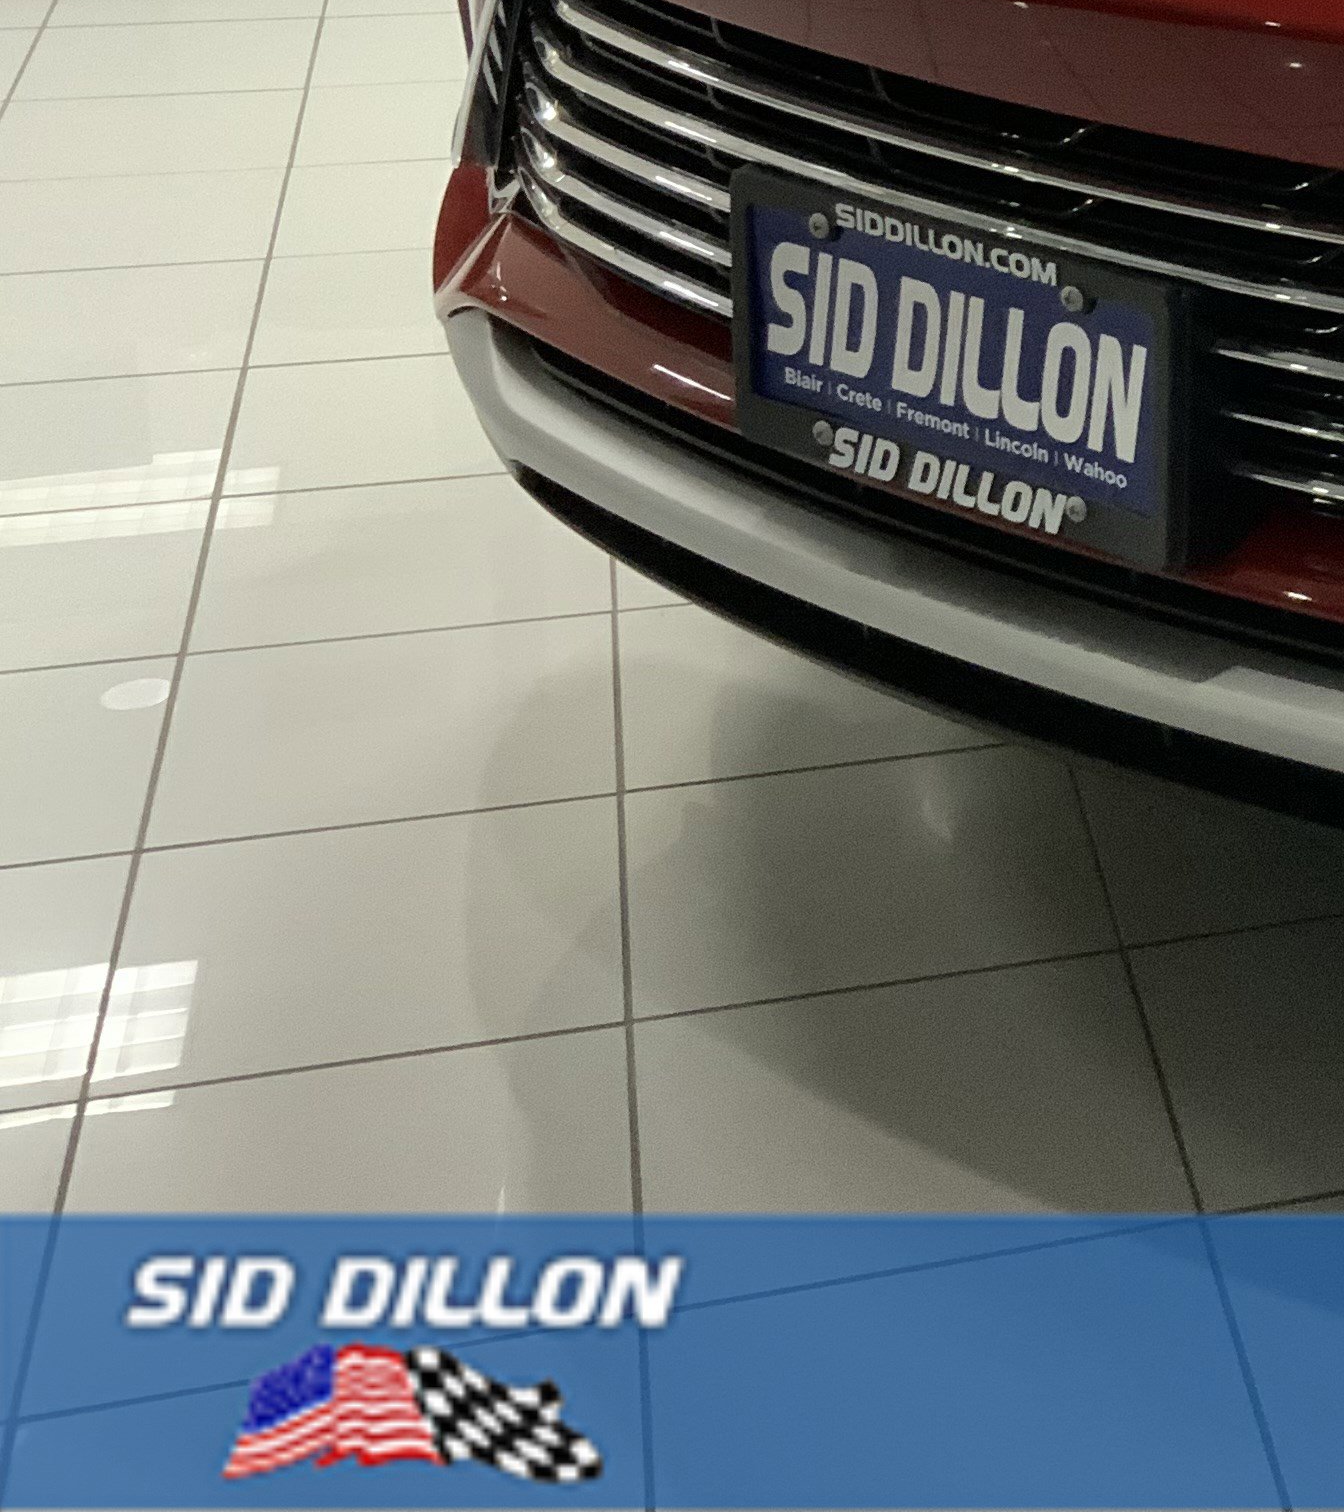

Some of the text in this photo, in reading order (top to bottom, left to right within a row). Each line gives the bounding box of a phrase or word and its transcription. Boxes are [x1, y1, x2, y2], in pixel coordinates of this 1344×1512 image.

[835, 202, 1057, 287] SIDDILLON.COM
[766, 241, 1148, 464] SID DILLON
[784, 366, 1128, 489] Blair Crete Fremont Lincoln Wahoo
[828, 426, 1068, 535] SID DILLON
